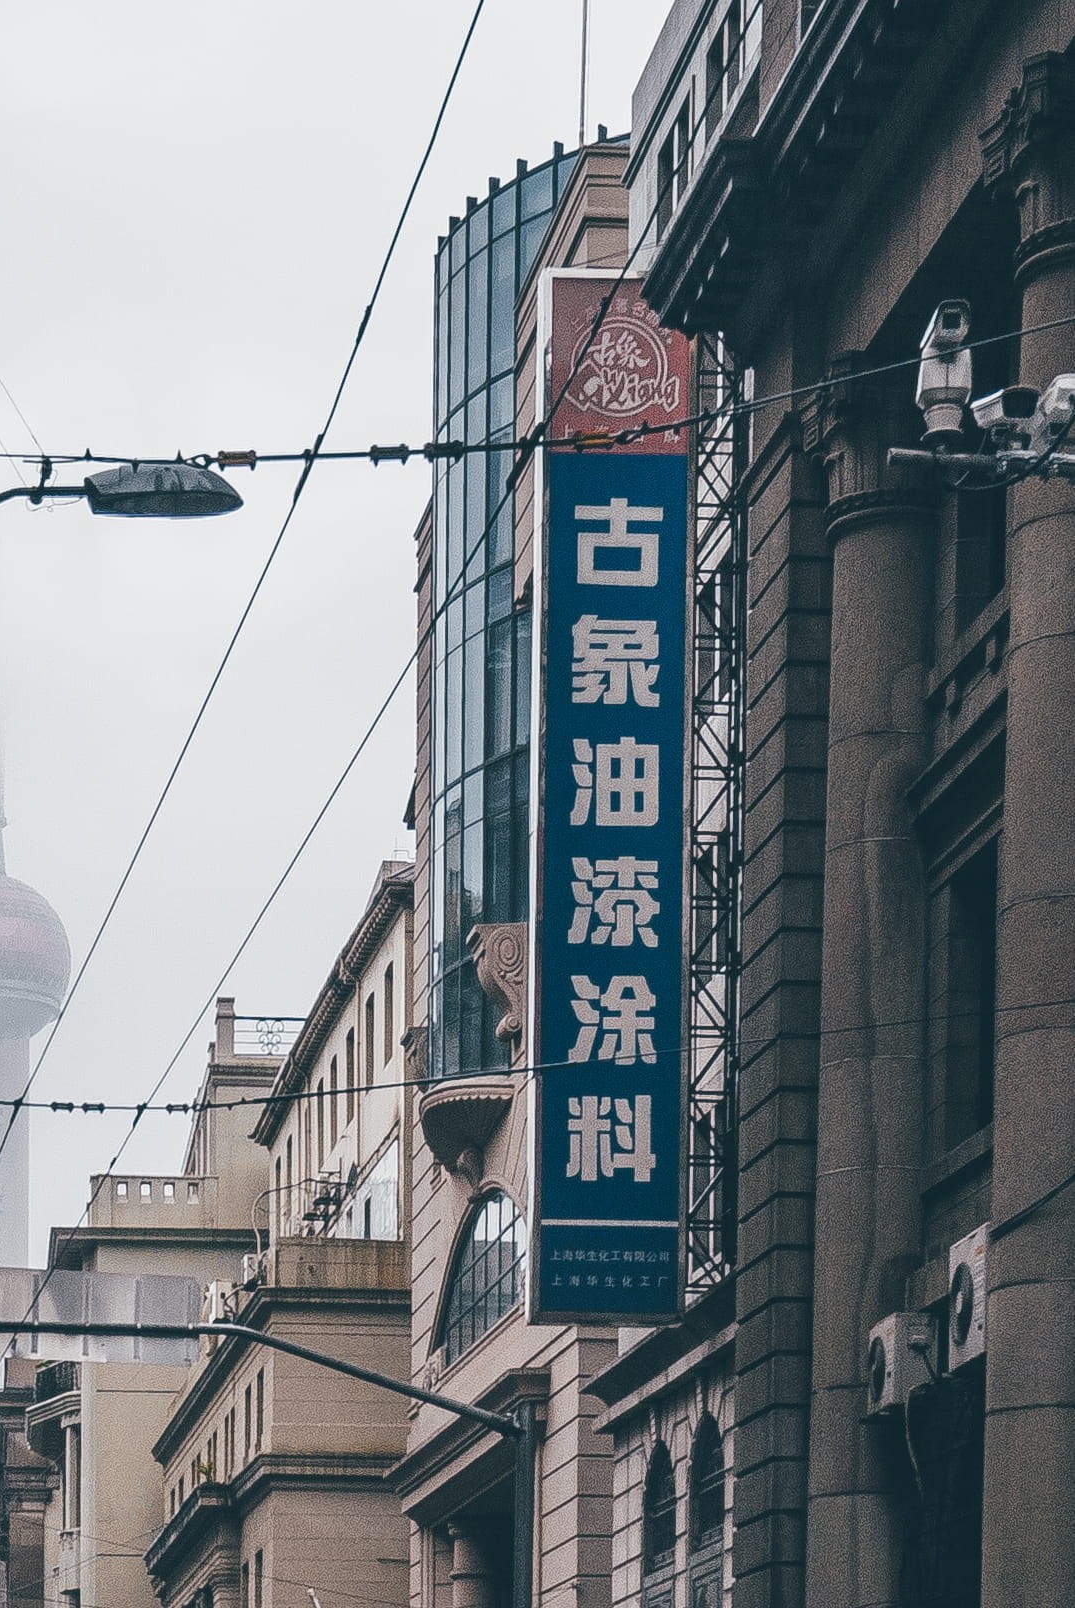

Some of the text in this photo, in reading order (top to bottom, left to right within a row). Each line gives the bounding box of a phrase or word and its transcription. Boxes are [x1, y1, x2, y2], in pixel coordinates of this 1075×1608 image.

[566, 497, 664, 1184] 古象油漆涂料
